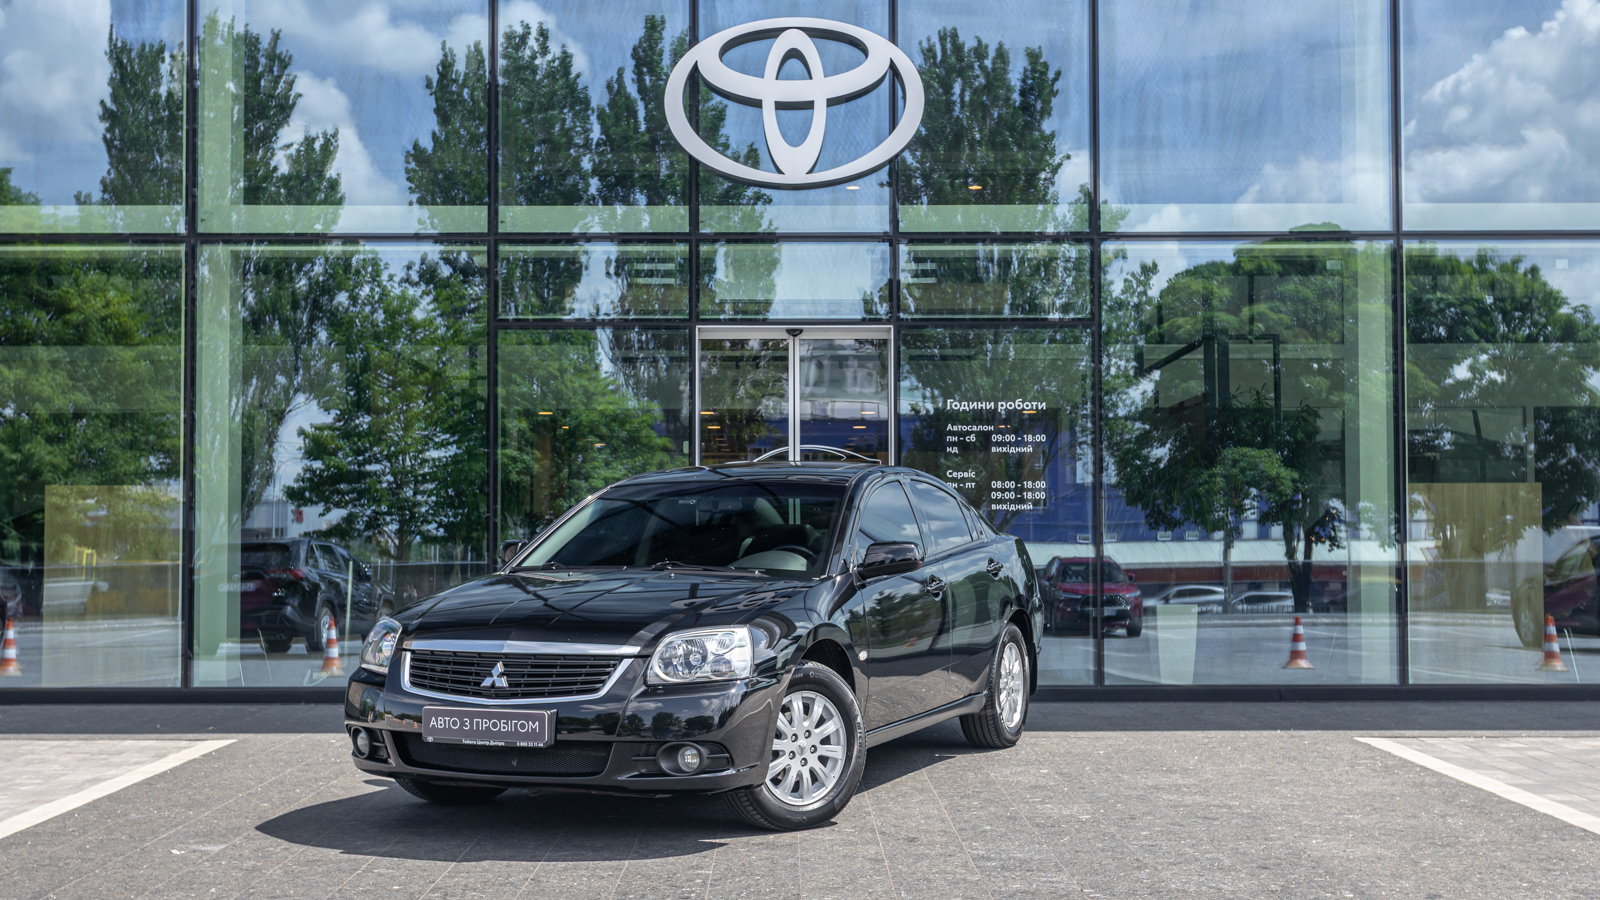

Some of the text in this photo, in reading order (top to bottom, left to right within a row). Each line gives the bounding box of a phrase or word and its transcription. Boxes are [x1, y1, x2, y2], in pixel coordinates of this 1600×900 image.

[946, 398, 1046, 412] Години роботи
[991, 445, 1033, 454] вихідний
[946, 470, 975, 479] Сервіс
[991, 502, 1033, 511] вихідний
[430, 716, 539, 733] АВТО З ПРОБІГОМ
